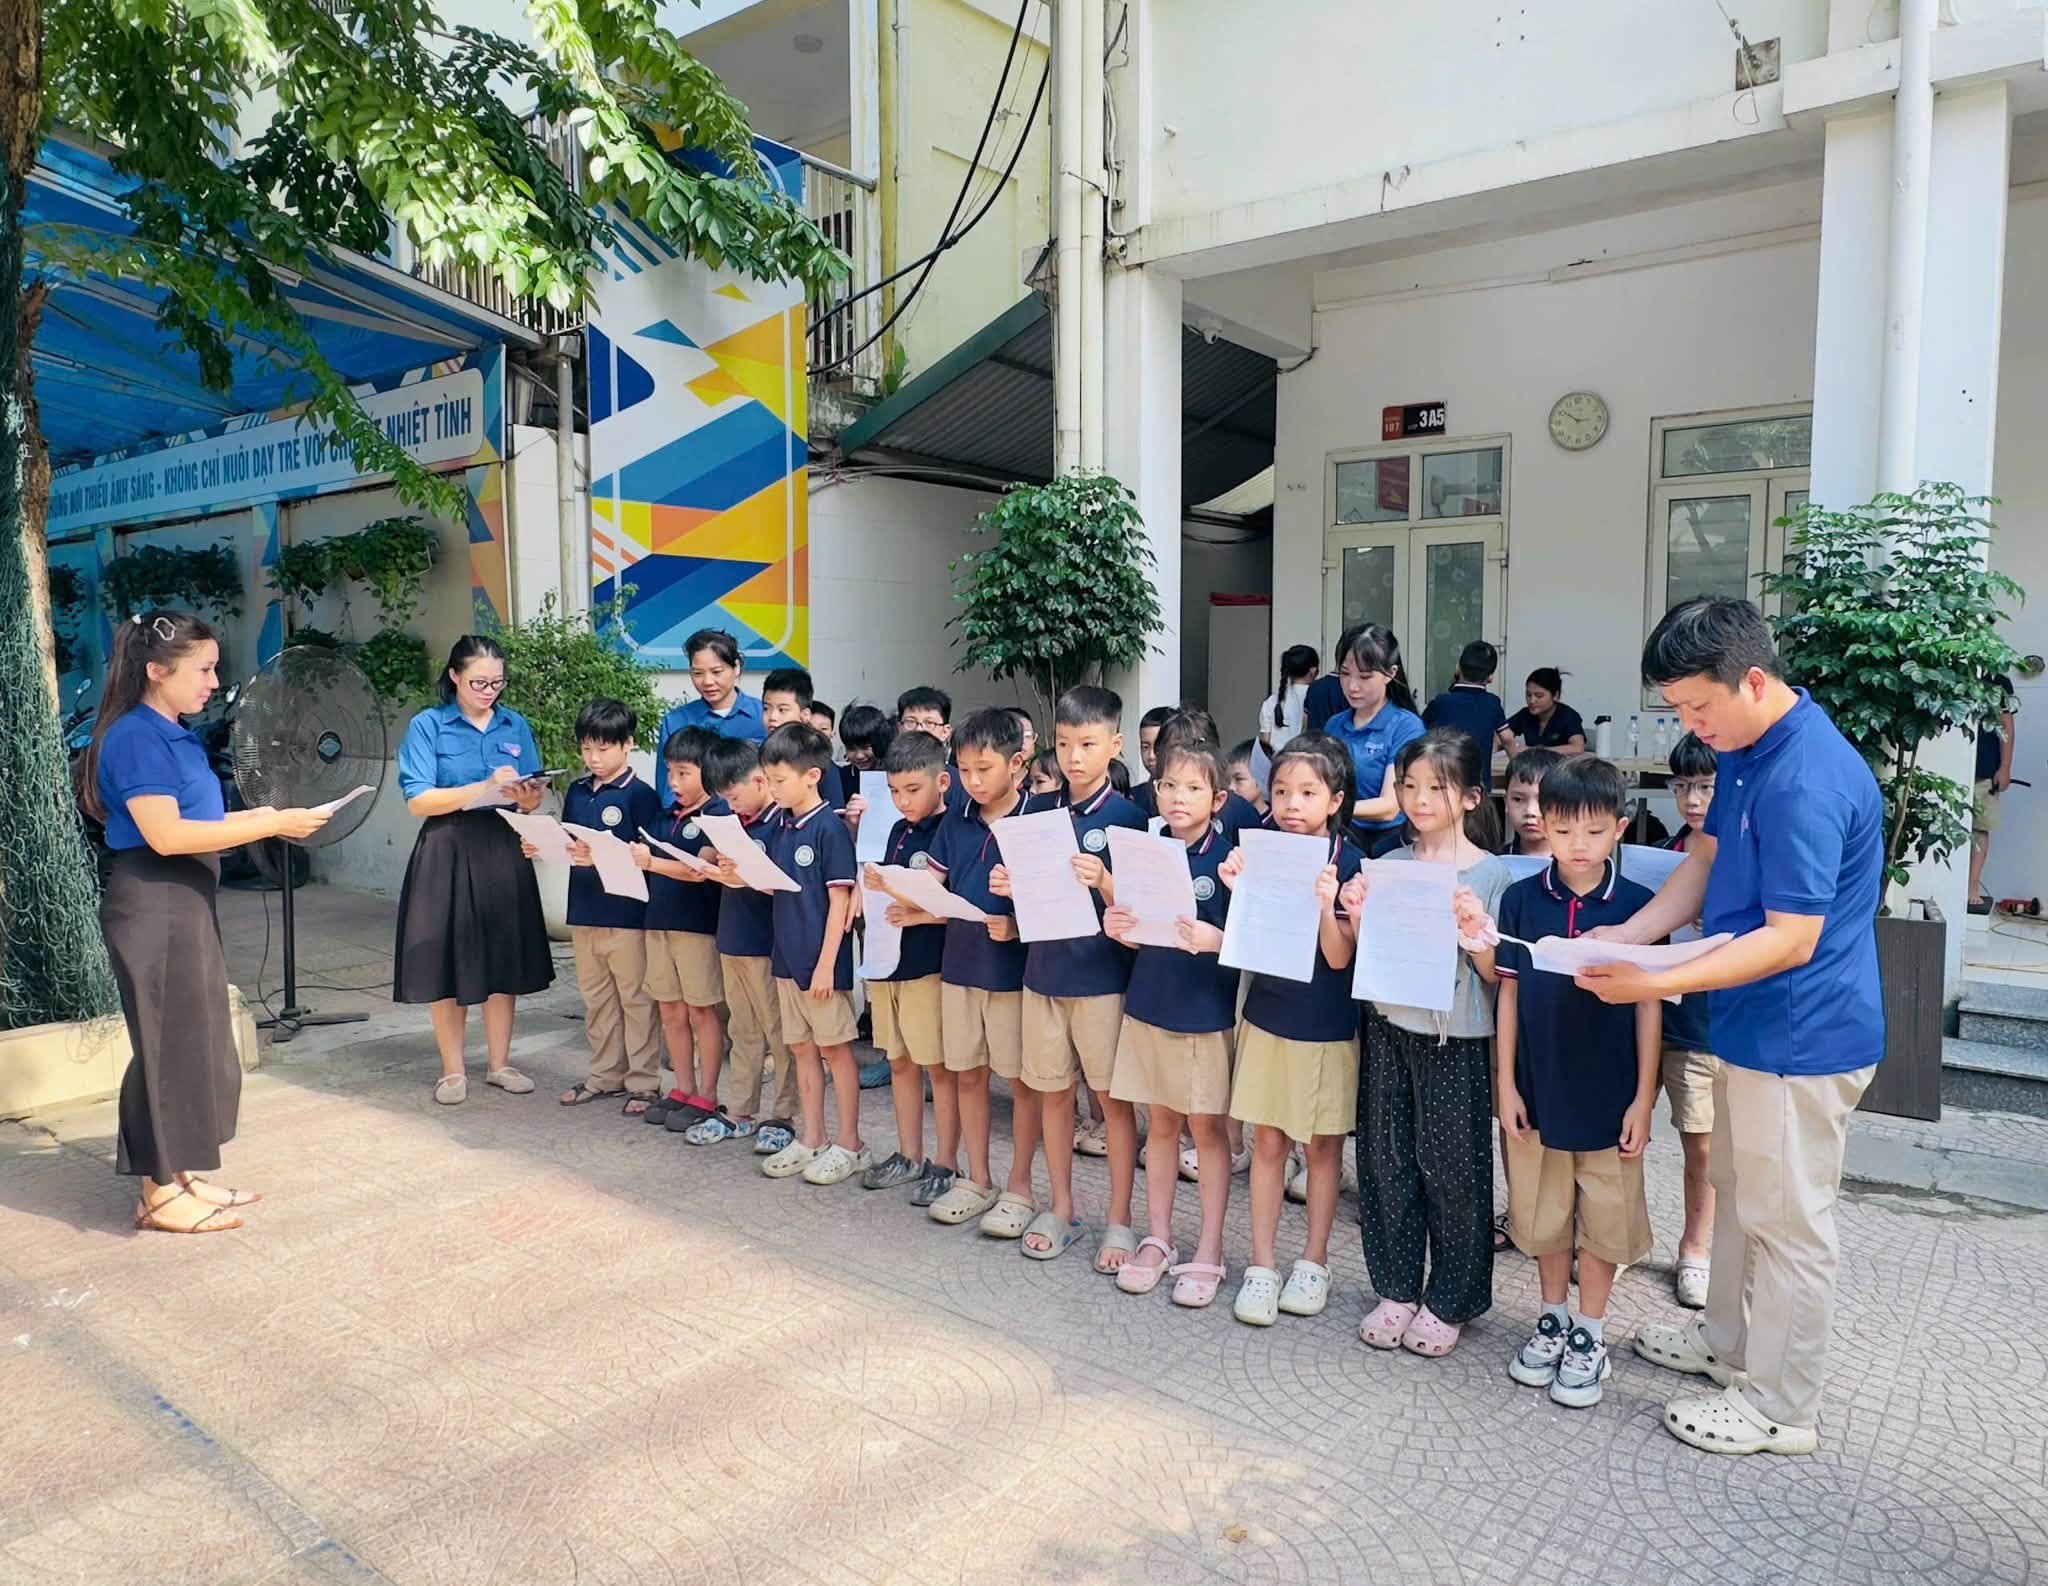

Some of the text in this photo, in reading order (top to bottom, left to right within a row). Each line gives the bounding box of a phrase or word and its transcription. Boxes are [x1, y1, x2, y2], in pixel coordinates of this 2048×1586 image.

[1385, 422, 1400, 432] 107
[1419, 408, 1445, 428] 3A5
[164, 458, 198, 497] KHÔNG
[223, 444, 249, 485] NUÔI
[253, 444, 275, 484] DẠY
[386, 400, 430, 451] NHIỆT
[434, 393, 472, 441] TÌNH
